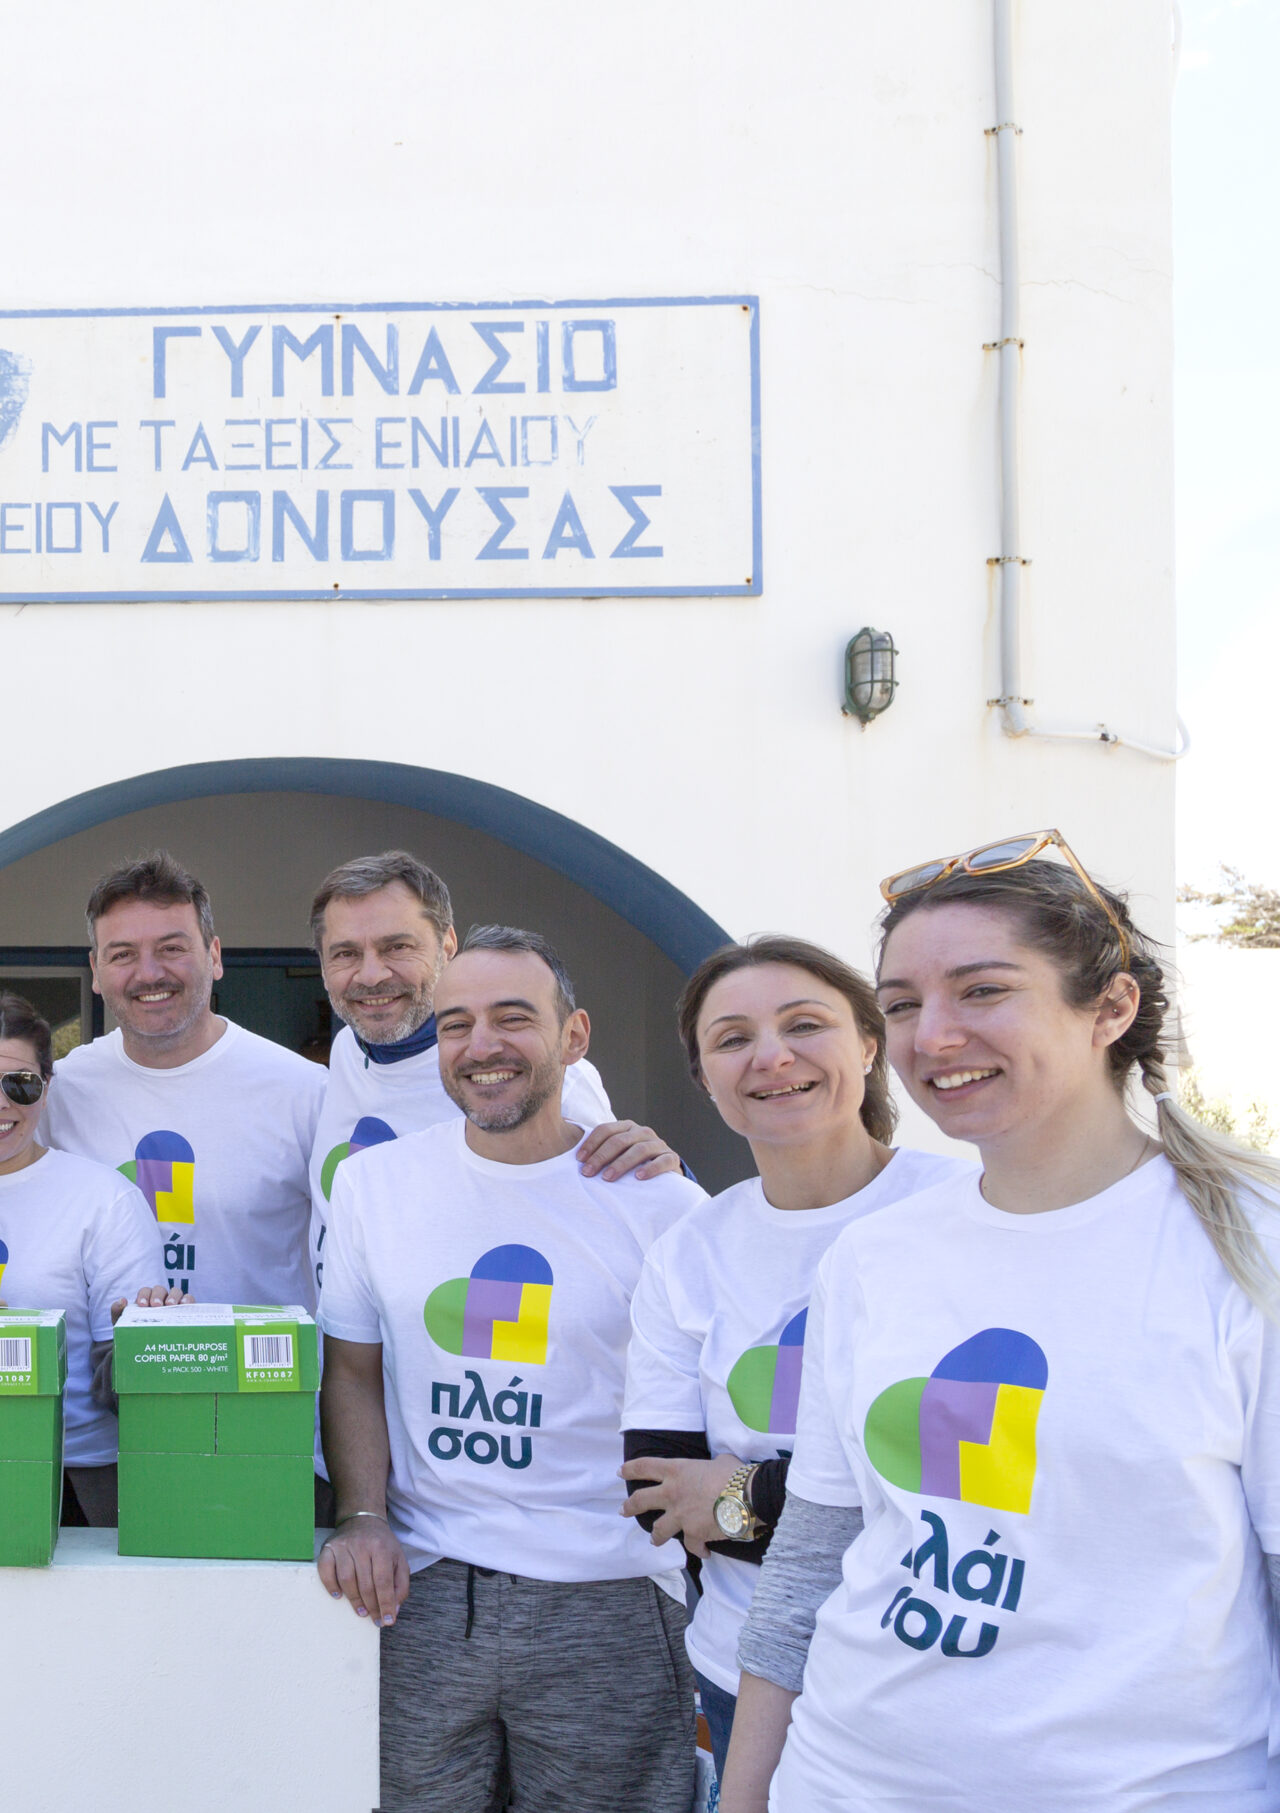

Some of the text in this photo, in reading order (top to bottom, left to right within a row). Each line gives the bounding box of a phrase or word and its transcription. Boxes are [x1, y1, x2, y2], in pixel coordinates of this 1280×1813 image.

[153, 319, 617, 399] ΓΥΜΝΑΣΙΟ
[41, 415, 597, 473] ΜΕ ΤΑΞΕΙΣ ΕΝΙΑΙΟΥ
[140, 484, 664, 563] ΔΟΝΟΥΣΑΣ
[164, 1232, 195, 1271] άι
[134, 1355, 167, 1363] COPIER
[170, 1354, 196, 1362] PAPER
[198, 1354, 208, 1362] 80
[144, 1343, 228, 1352] A4 MULTI-PURPOSE
[206, 1365, 228, 1373] WHITE
[431, 1370, 543, 1428] πλάι
[428, 1426, 532, 1470] σου
[900, 1510, 1025, 1612] λάι
